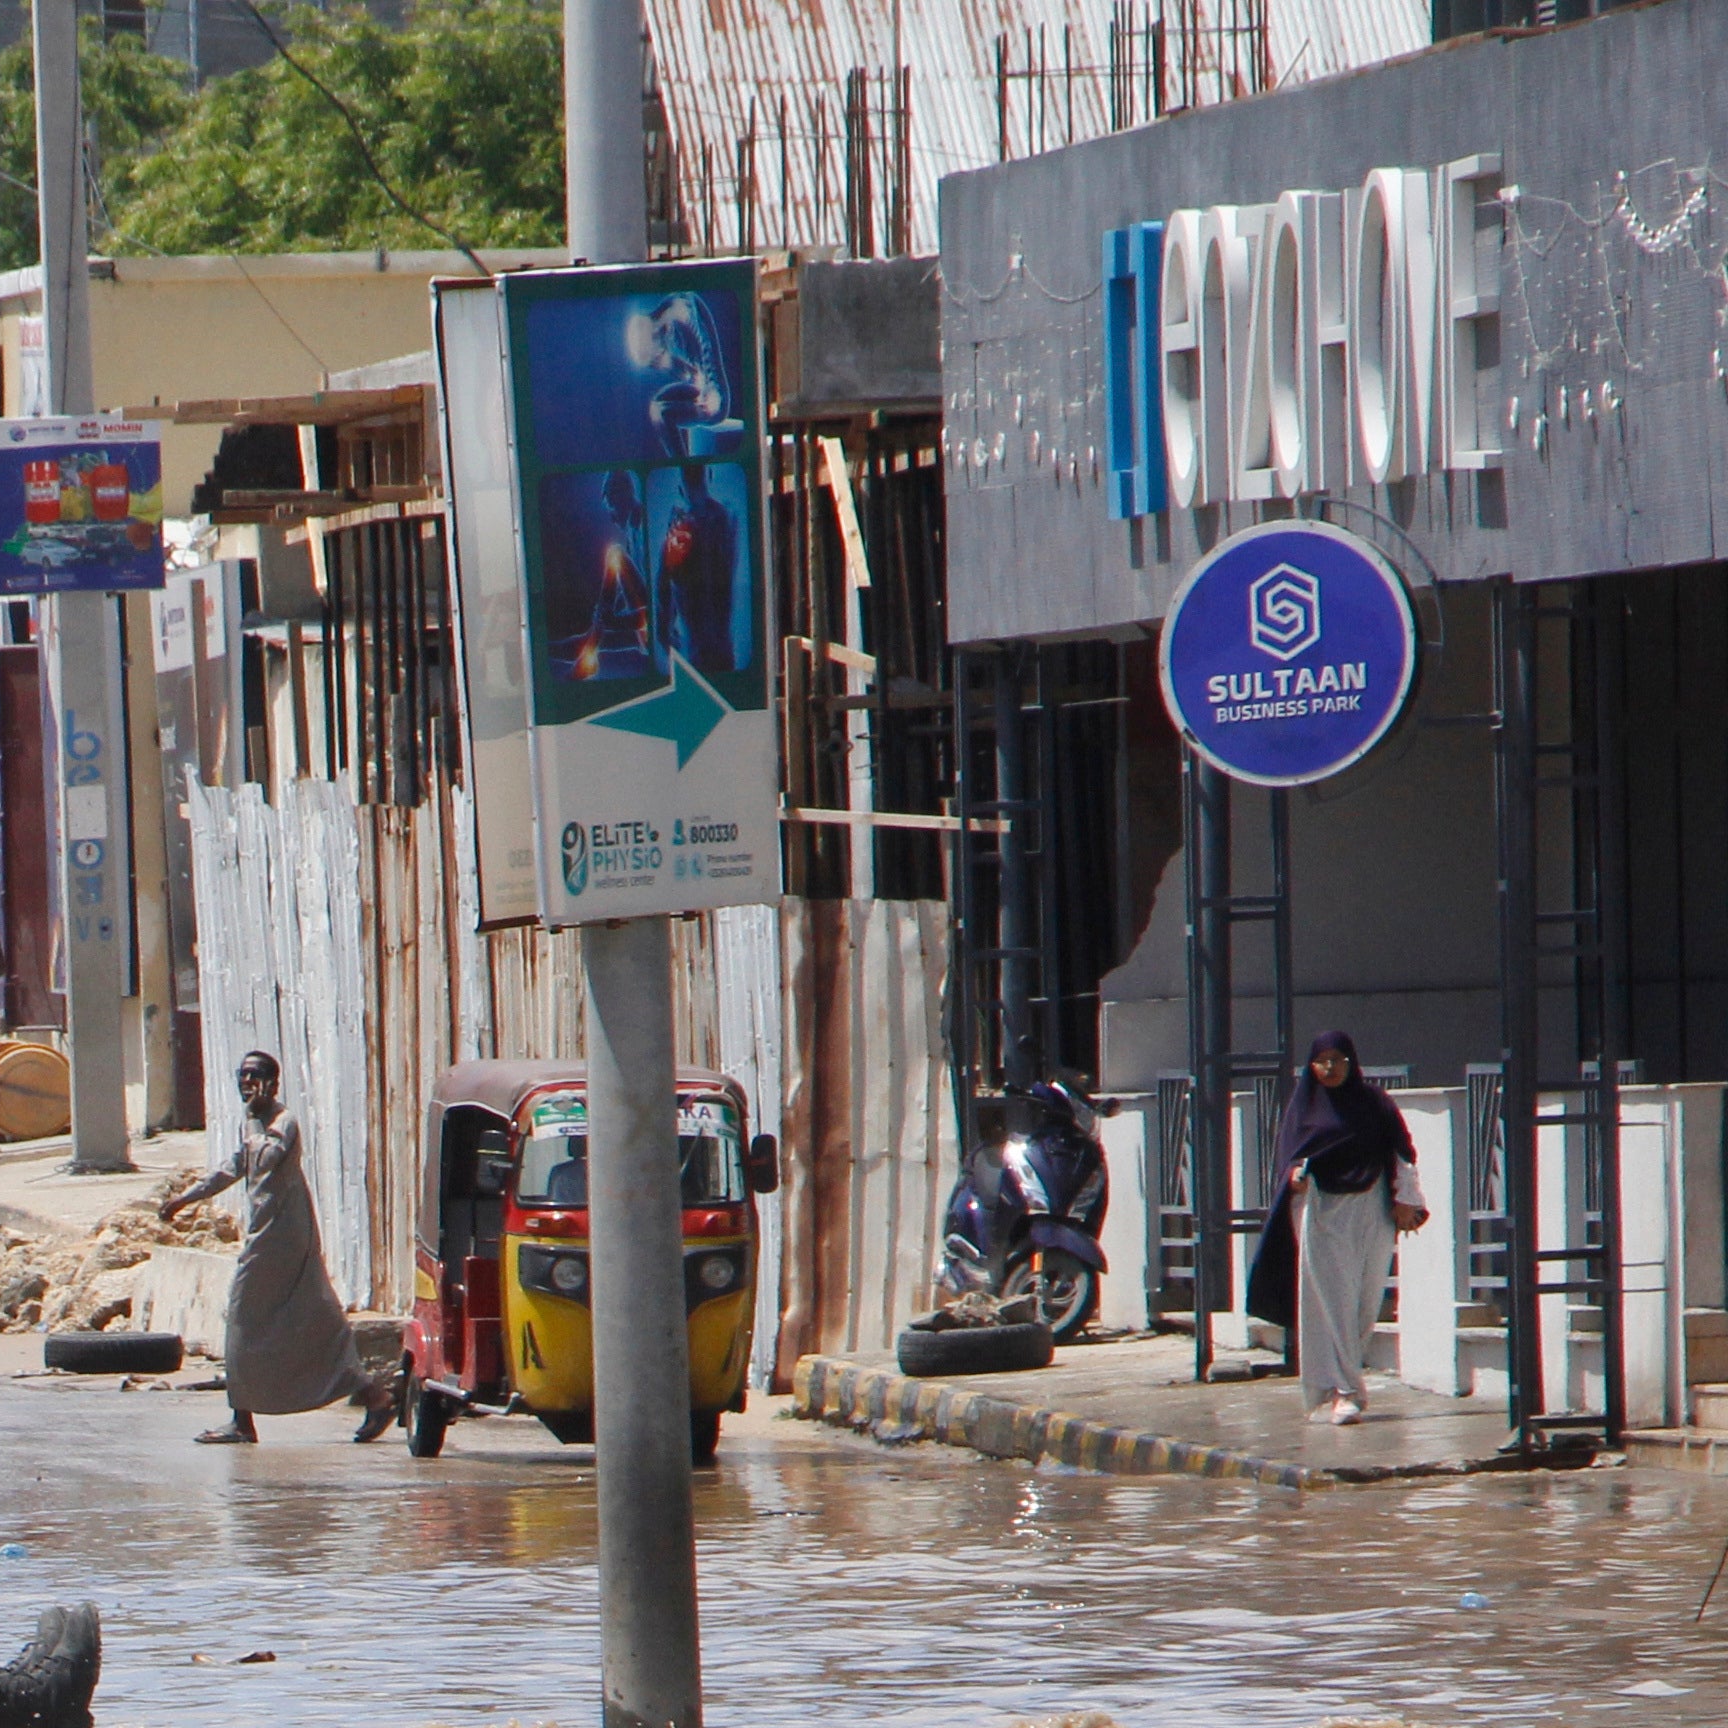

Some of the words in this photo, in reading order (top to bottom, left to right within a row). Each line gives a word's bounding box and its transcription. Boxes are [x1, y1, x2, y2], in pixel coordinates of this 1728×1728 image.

[1208, 662, 1367, 703] SULTAAN
[1216, 700, 1308, 724] BUSINESS
[1312, 694, 1362, 714] PARK
[691, 823, 738, 844] 800330
